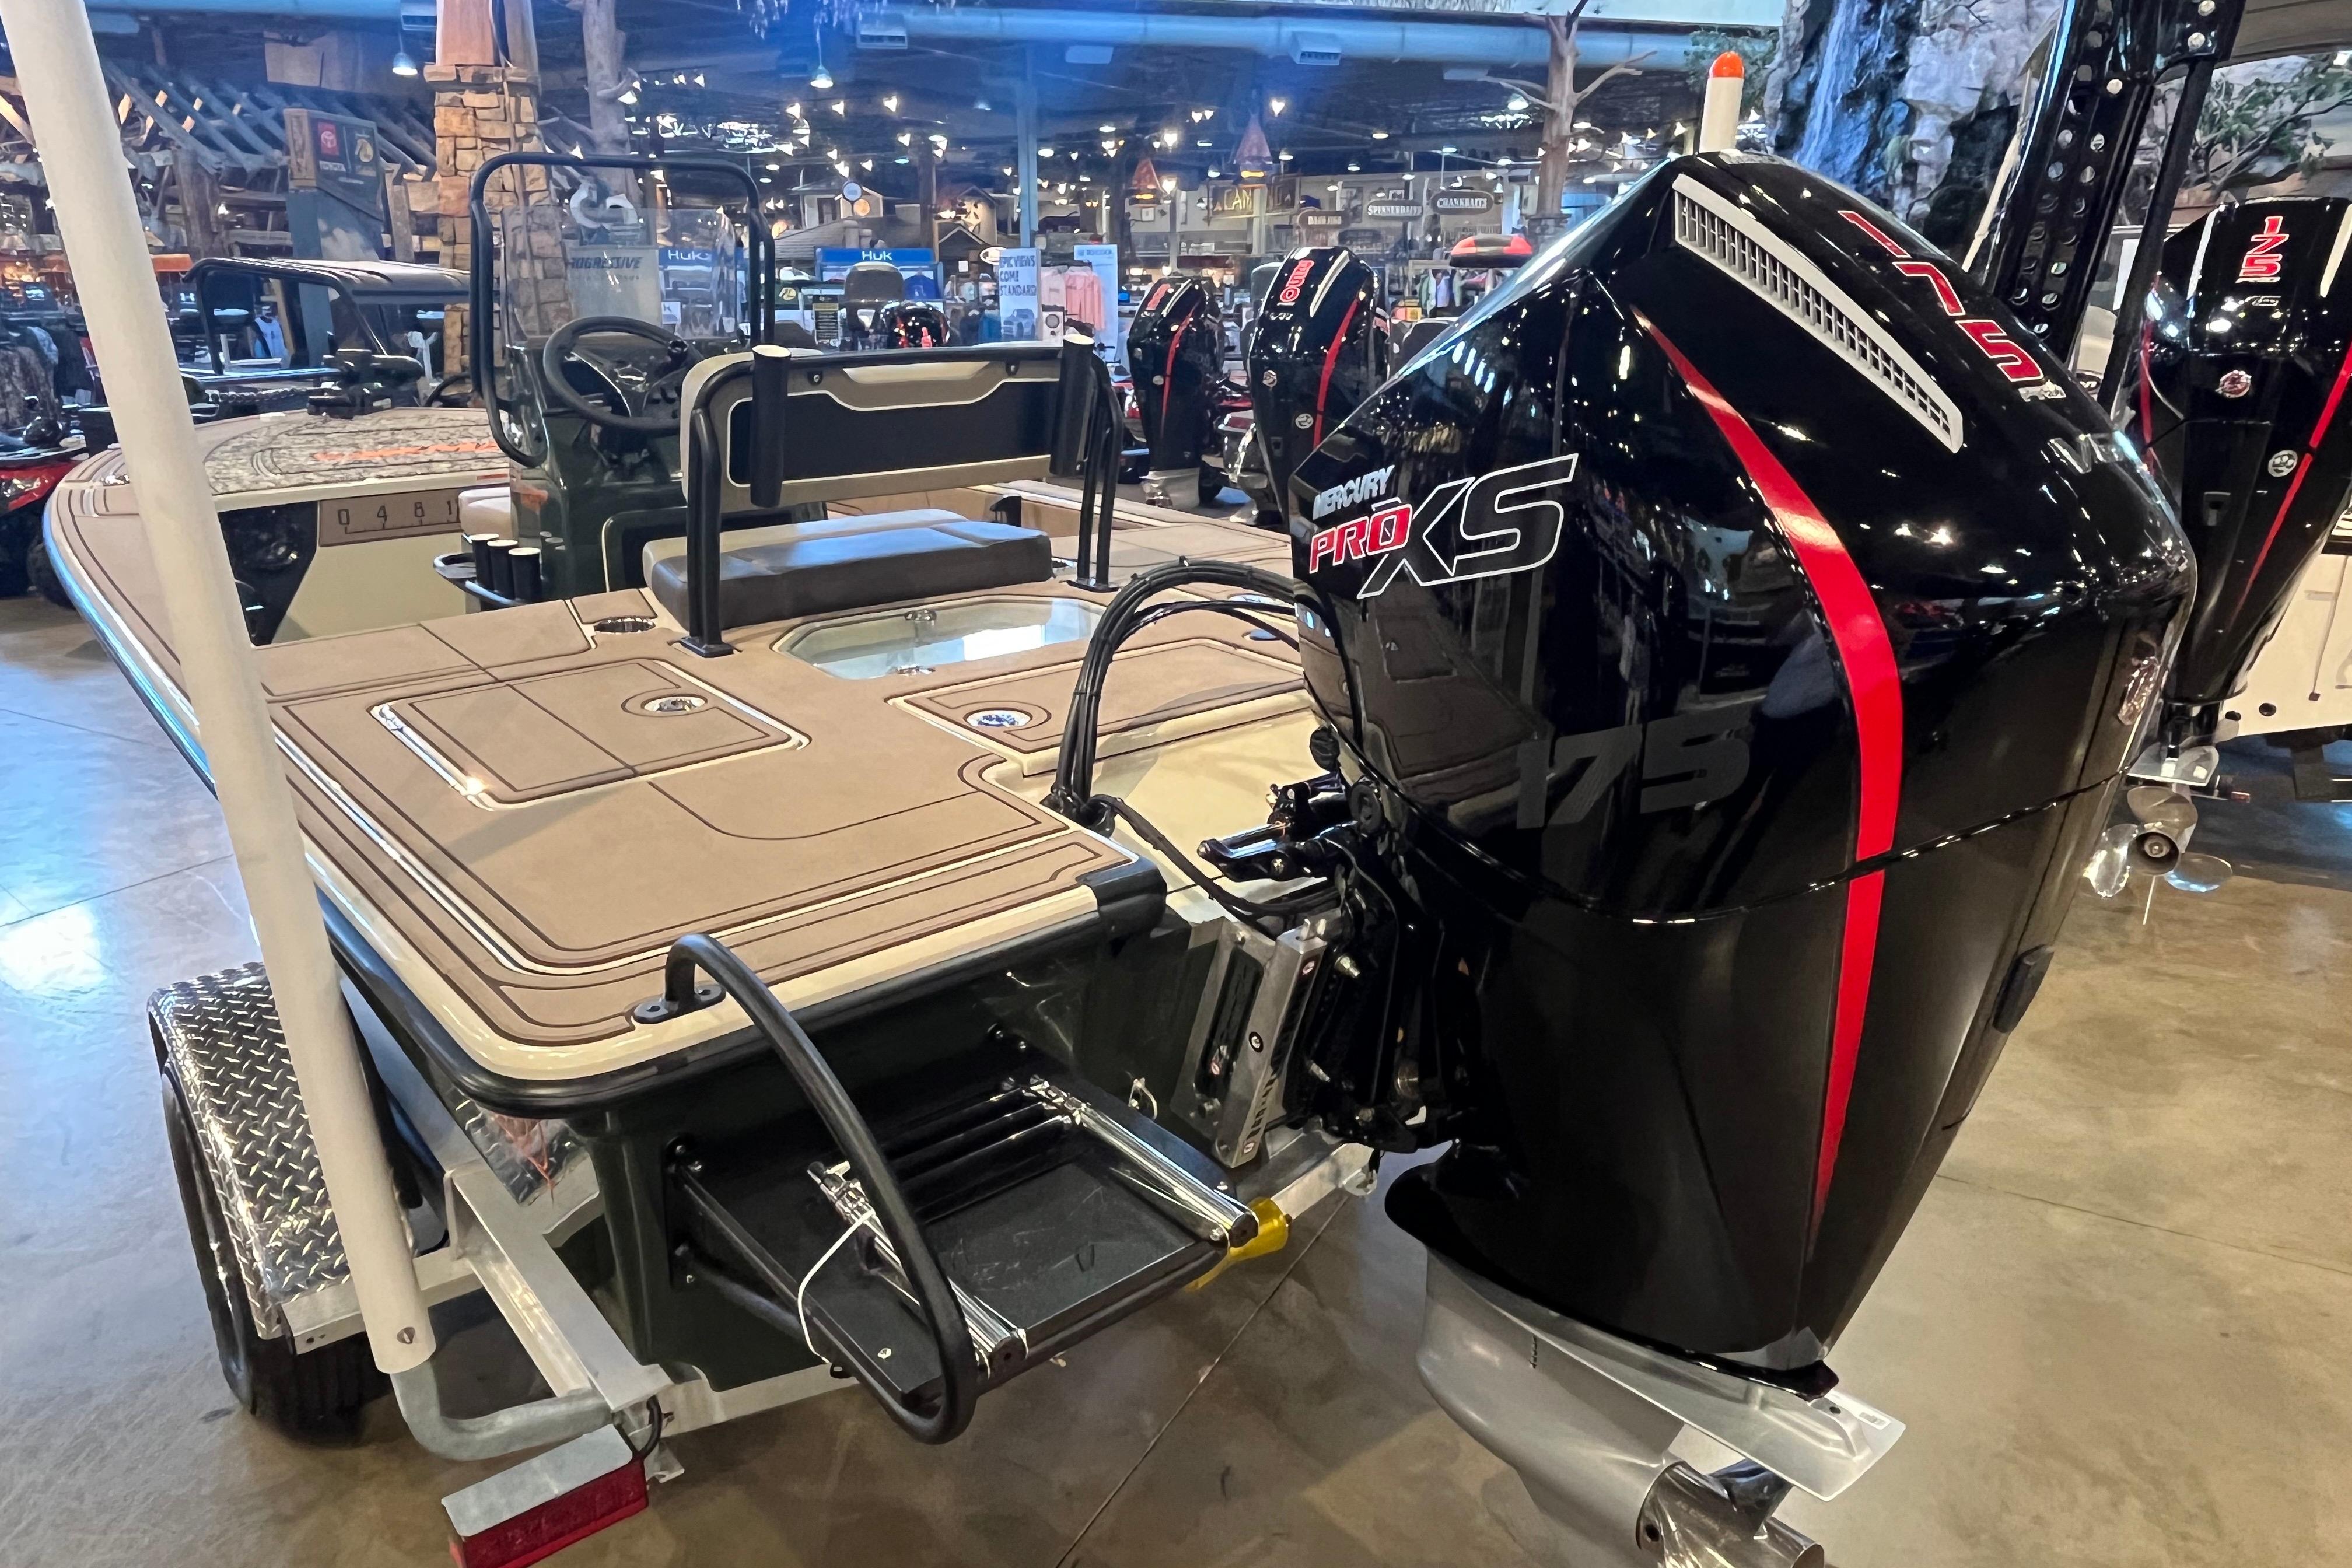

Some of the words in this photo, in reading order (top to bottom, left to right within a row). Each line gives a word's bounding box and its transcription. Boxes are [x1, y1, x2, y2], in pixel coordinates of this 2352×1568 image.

[862, 250, 892, 261] Huk
[2239, 216, 2289, 277] 175
[1838, 210, 2044, 382] 175
[1312, 464, 1395, 520] MERCURY
[1356, 452, 1578, 600] XS
[1309, 503, 1413, 575] PRO
[1517, 703, 1751, 830] 175
